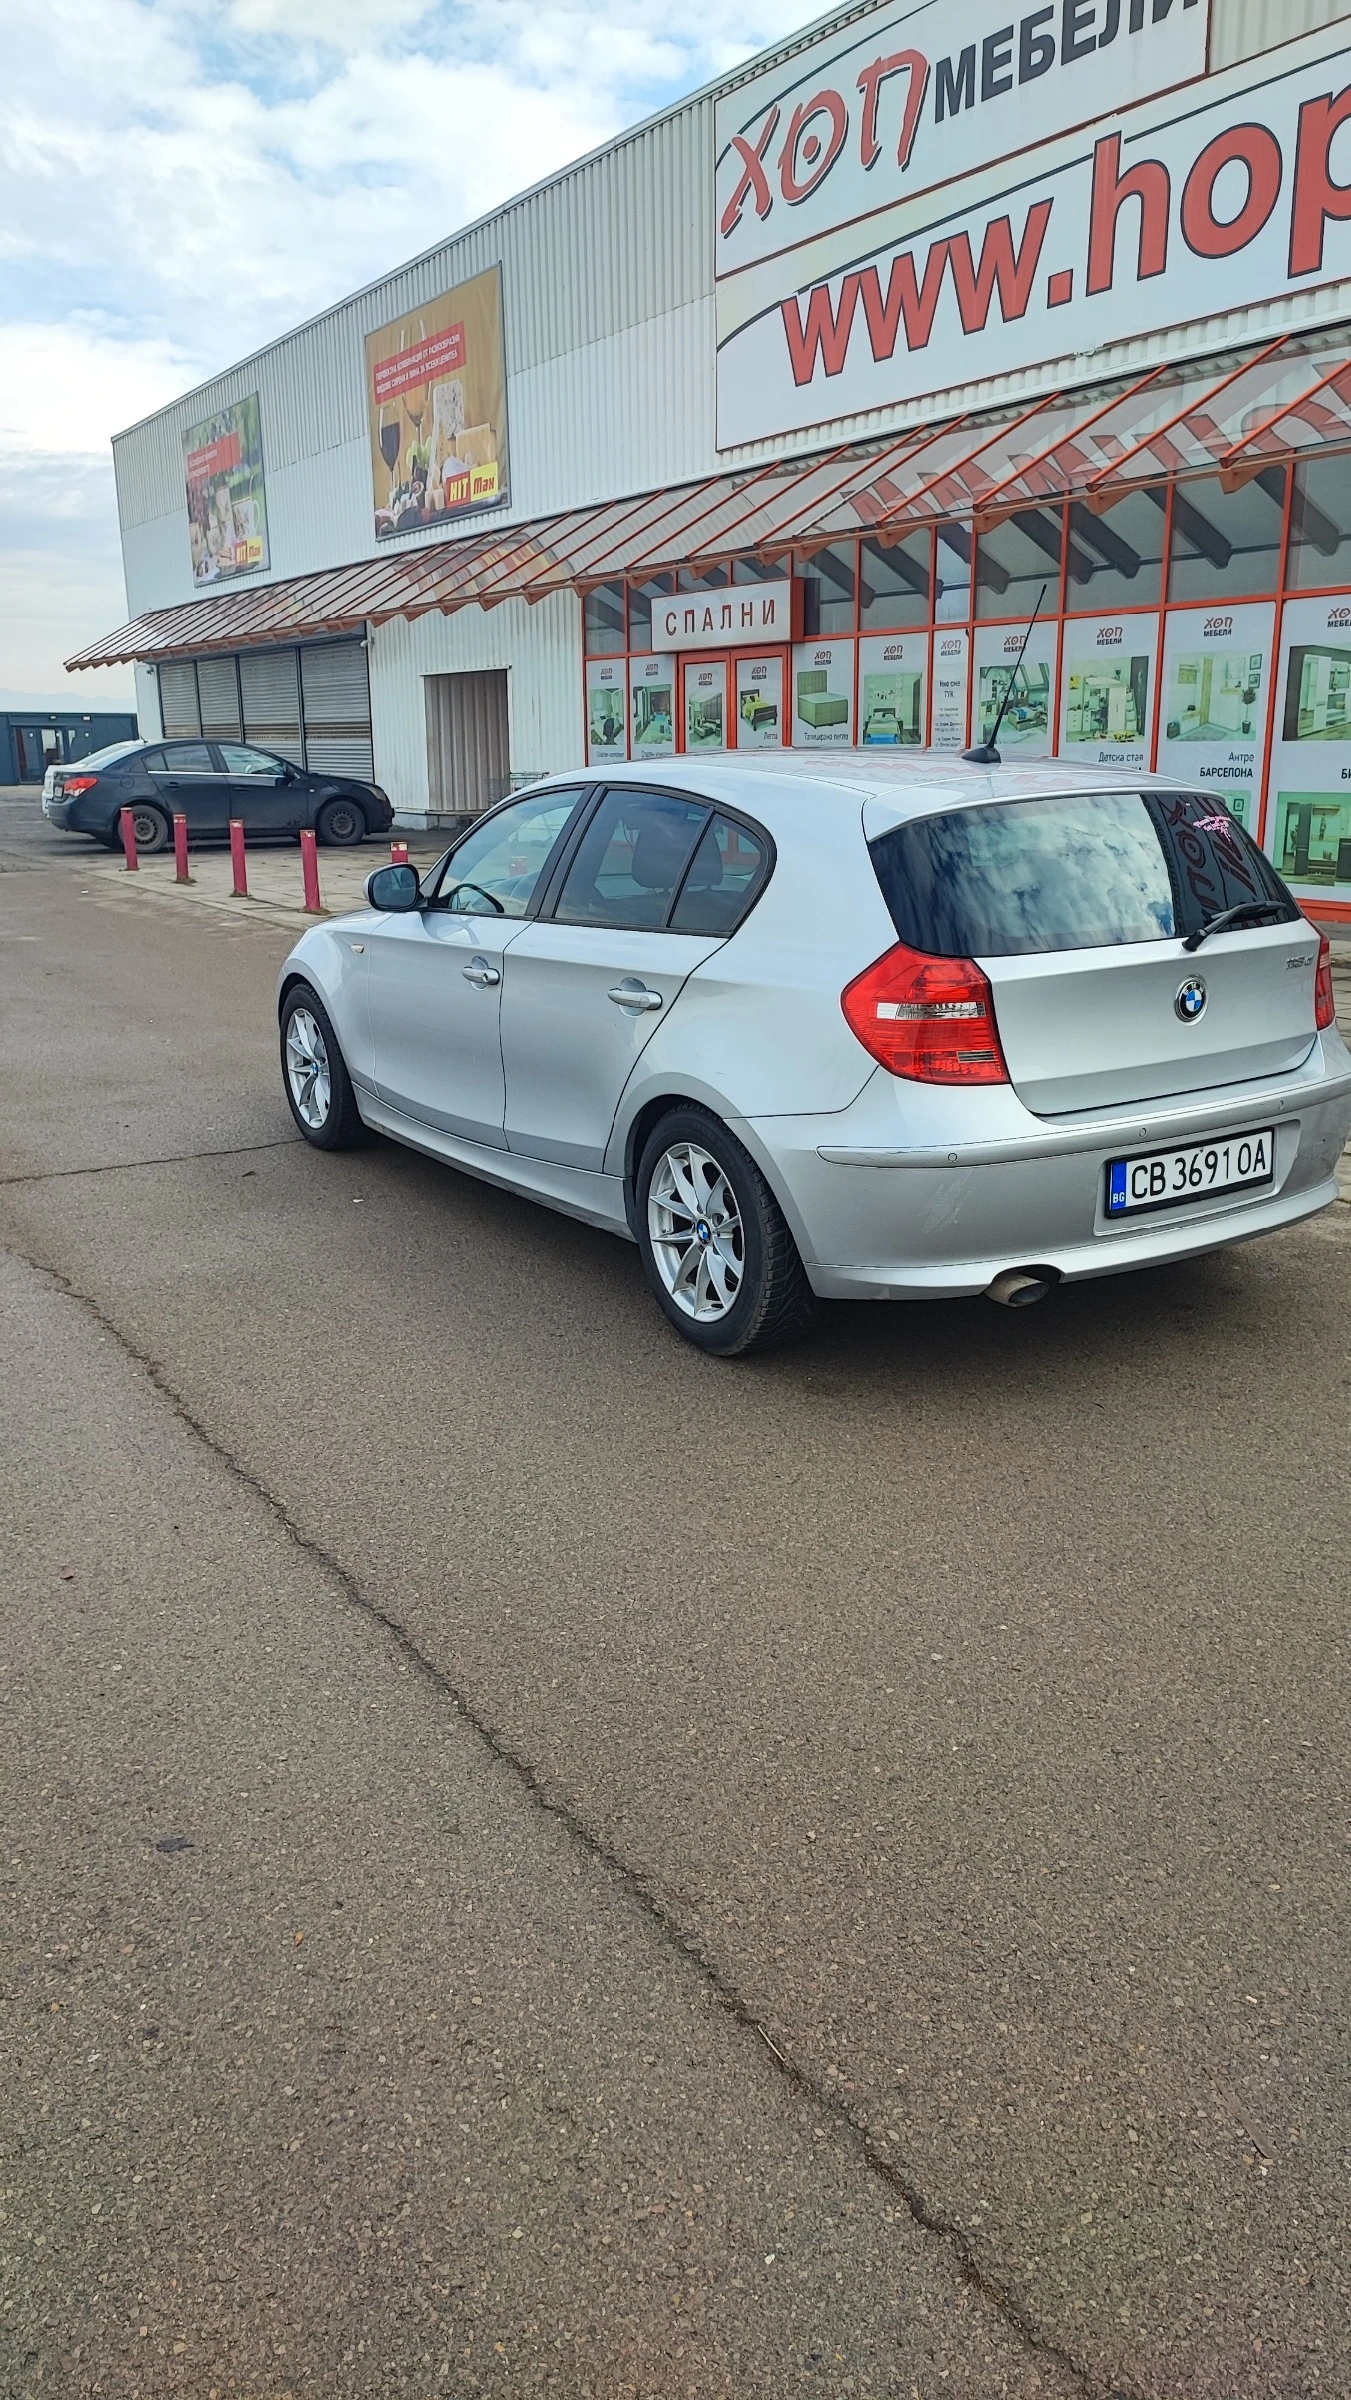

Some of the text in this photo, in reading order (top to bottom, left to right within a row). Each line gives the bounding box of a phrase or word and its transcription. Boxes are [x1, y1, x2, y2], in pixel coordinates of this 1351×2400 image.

[720, 0, 1199, 239] ХОП МЕБЕЛ
[450, 476, 494, 502] HIT Max
[666, 599, 774, 636] СПАЛНИ
[1204, 616, 1233, 630] ХОП
[1327, 620, 1351, 628] МЕБЕ
[1096, 626, 1122, 638] ХОП
[1204, 629, 1232, 637] МЕБЕЛИ
[940, 640, 962, 650] ХОП
[1096, 638, 1122, 646] МЕБЕЛИ
[884, 645, 903, 654] ХОП
[814, 650, 832, 660] ХОП
[751, 666, 767, 674] ХОП
[1098, 752, 1143, 762] Детска стая
[1228, 752, 1254, 763] Антре
[1200, 767, 1253, 778] БАРСЕЛОНА
[1112, 1192, 1125, 1204] BG
